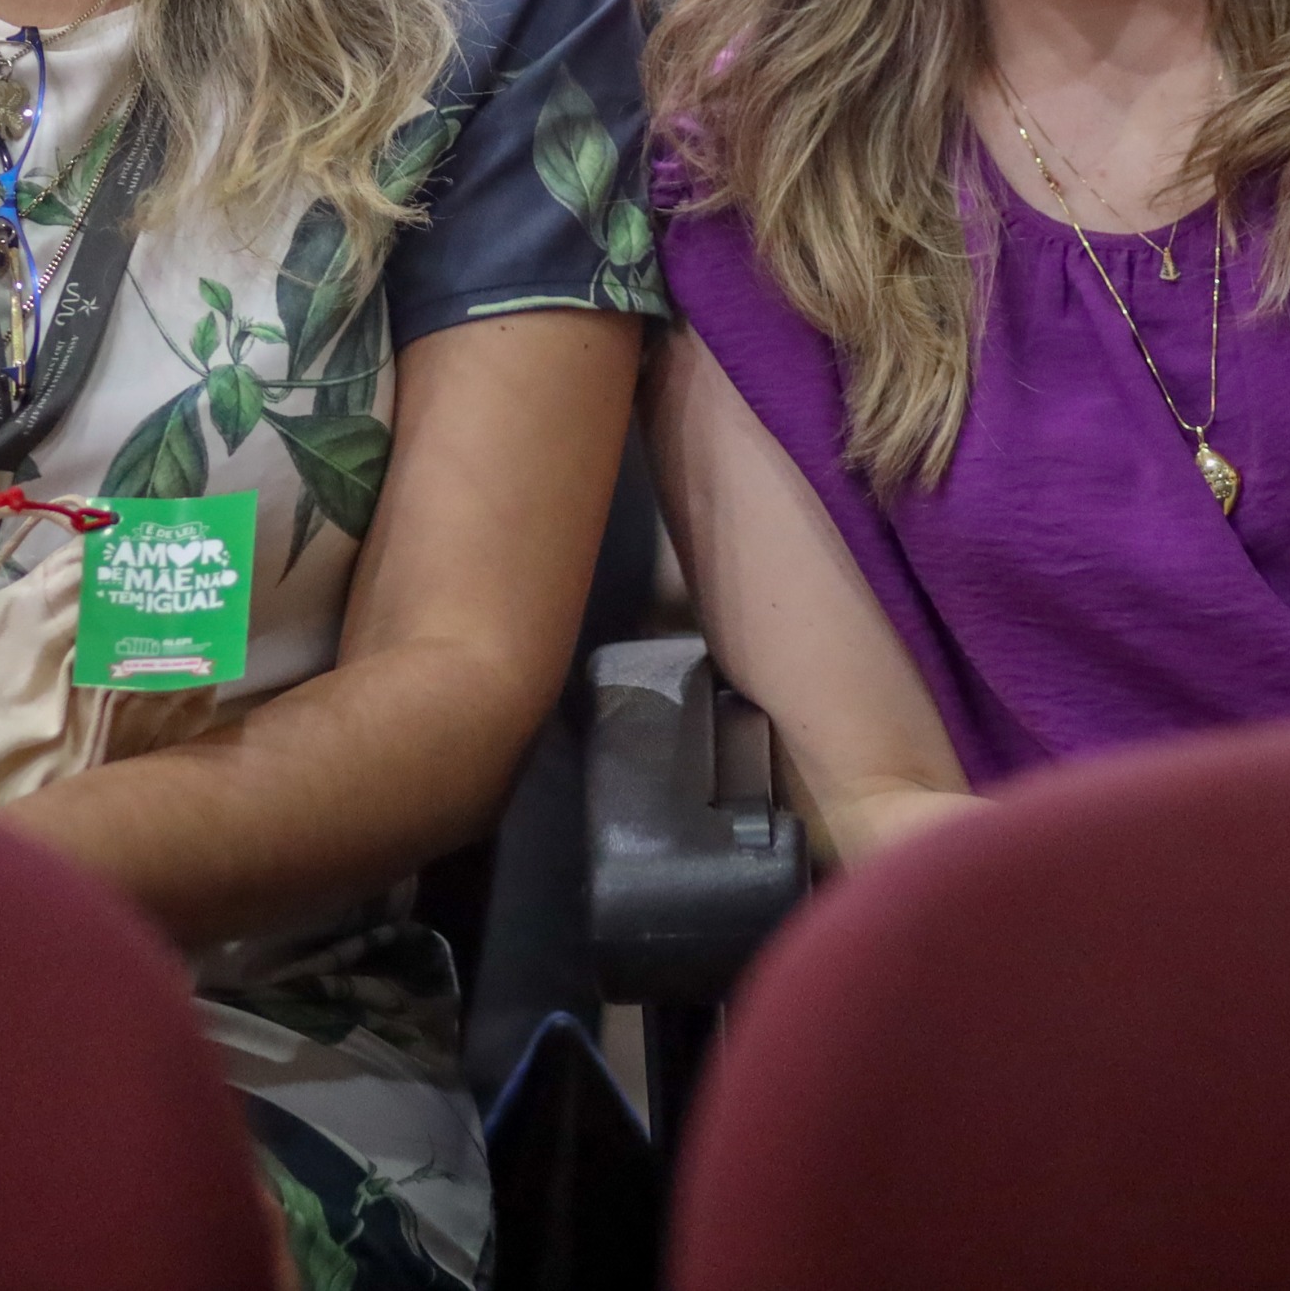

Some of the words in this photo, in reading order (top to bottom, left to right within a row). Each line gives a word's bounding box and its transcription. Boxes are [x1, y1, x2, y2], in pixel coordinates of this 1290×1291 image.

[97, 566, 123, 582] DE
[124, 567, 195, 591] MÃE
[195, 569, 238, 590] NÃO
[108, 590, 145, 605] TEM
[145, 589, 224, 614] IGUAL
